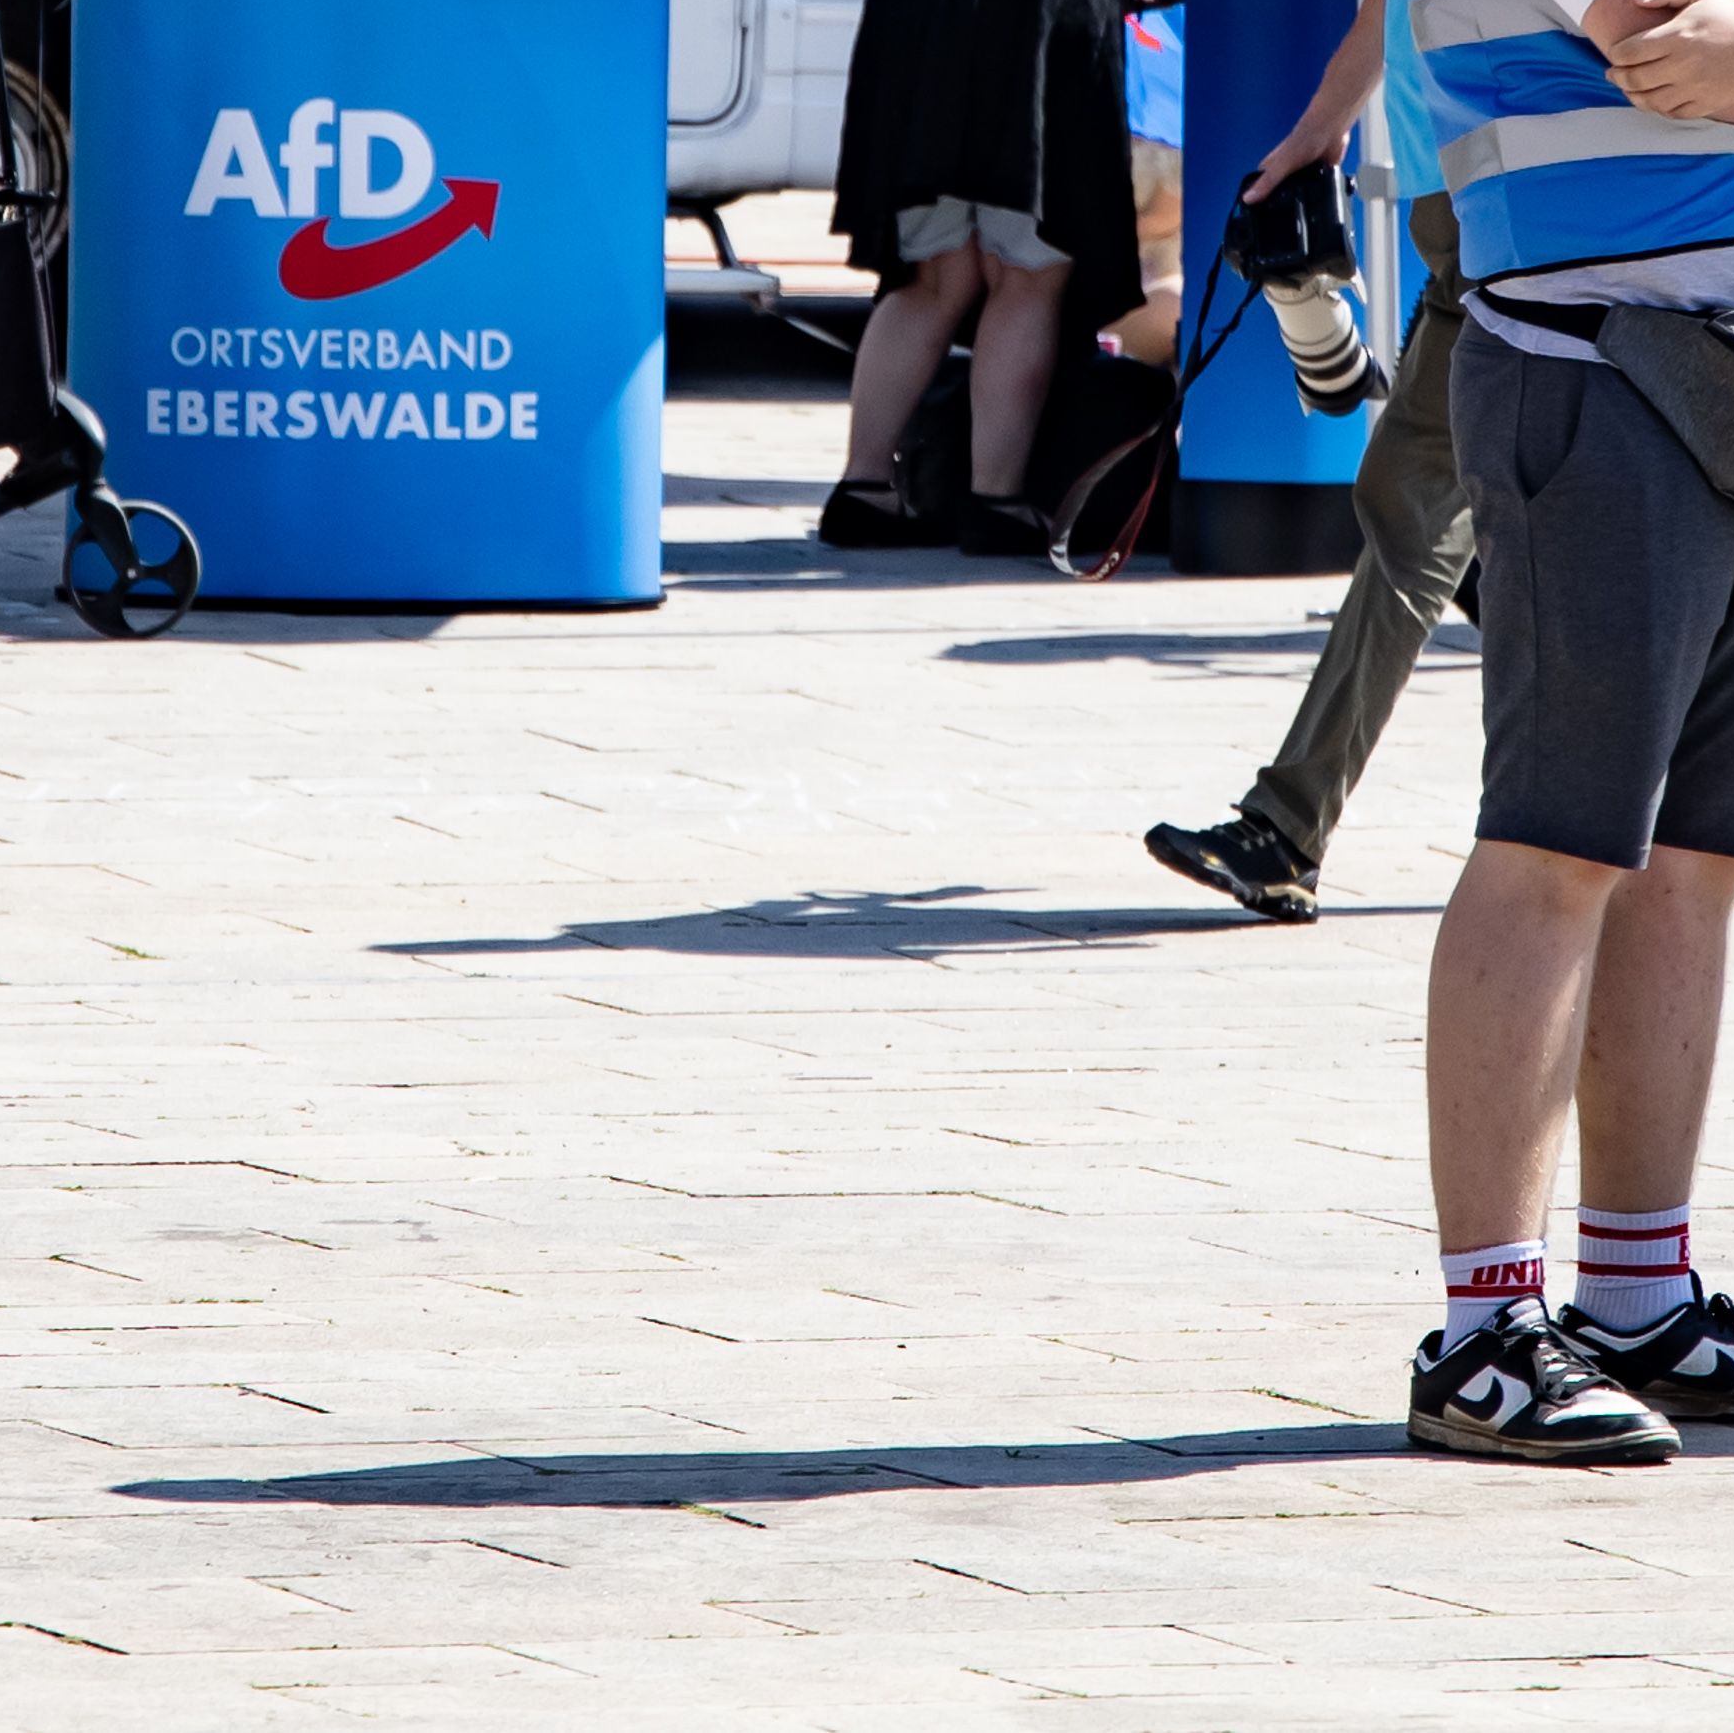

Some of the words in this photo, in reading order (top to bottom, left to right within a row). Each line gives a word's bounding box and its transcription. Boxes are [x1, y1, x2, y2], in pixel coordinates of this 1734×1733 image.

[183, 97, 436, 219] AfD
[170, 326, 514, 372] ORTSVERBAND
[146, 388, 539, 441] EBERSWALDE
